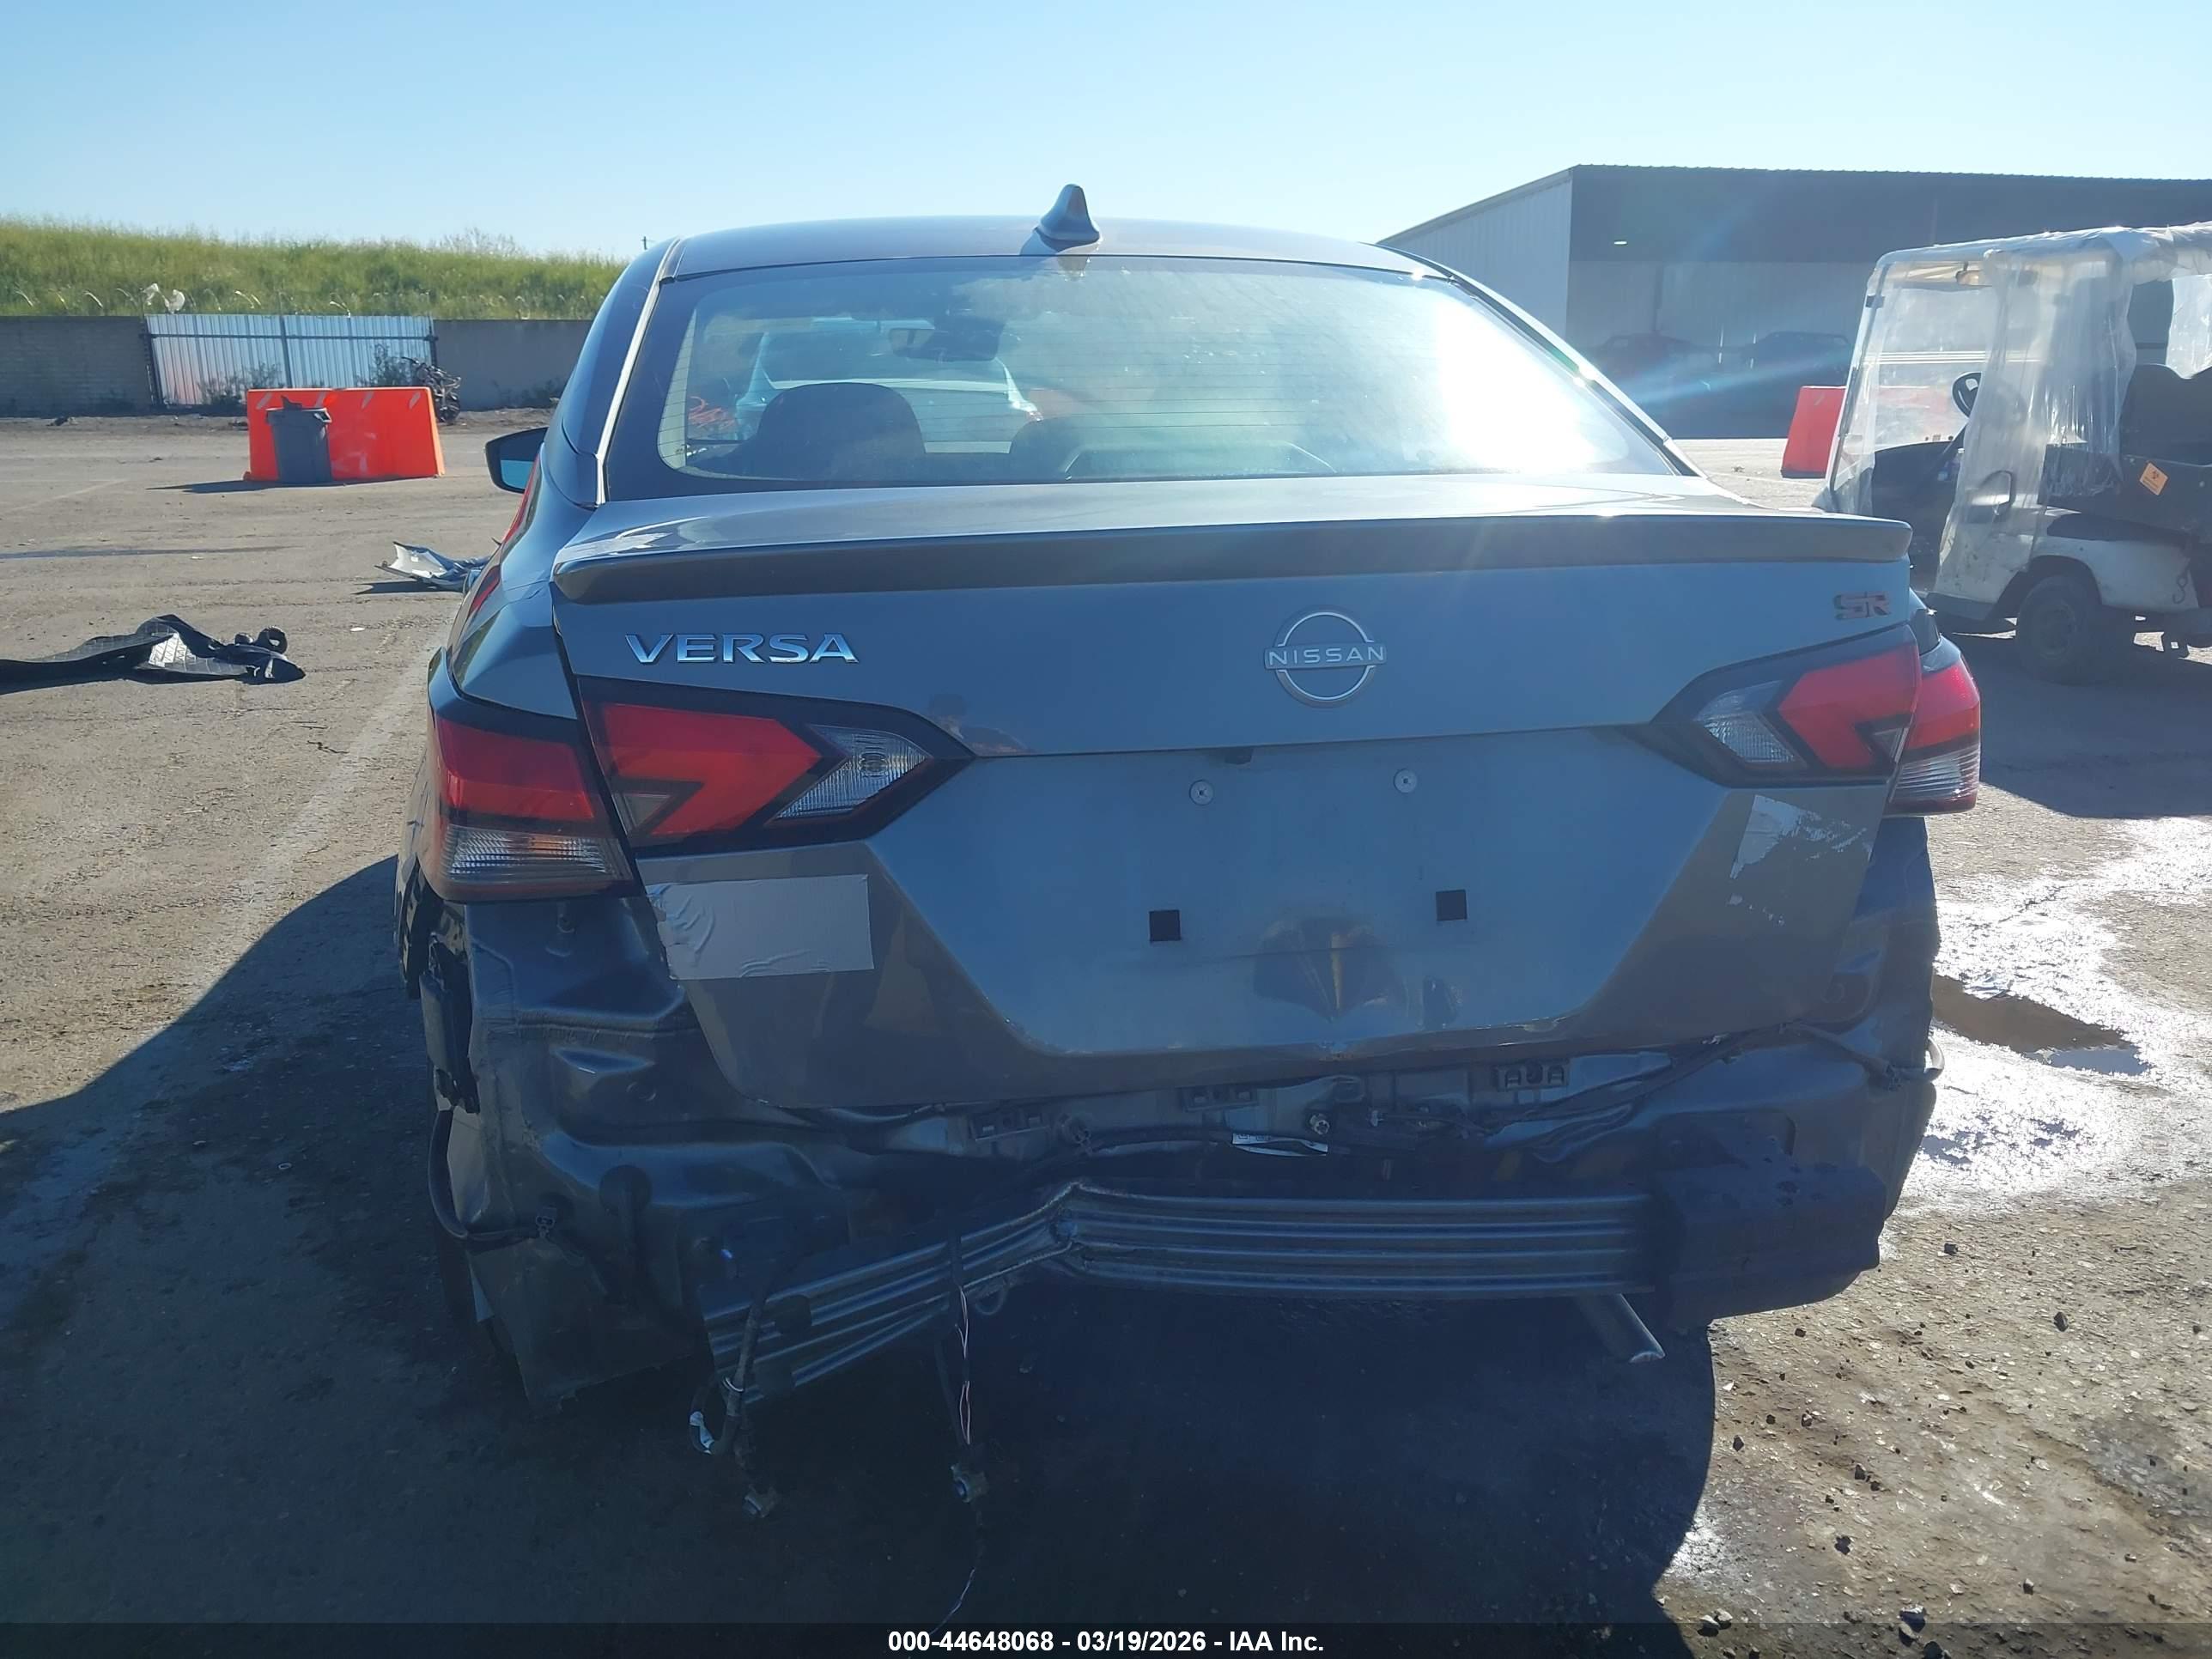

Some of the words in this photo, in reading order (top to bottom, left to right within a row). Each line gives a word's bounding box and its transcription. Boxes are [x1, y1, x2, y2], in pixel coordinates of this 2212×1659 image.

[1833, 591, 1889, 619] SR
[625, 633, 859, 663] VERSA
[1269, 647, 1383, 665] NISSAN
